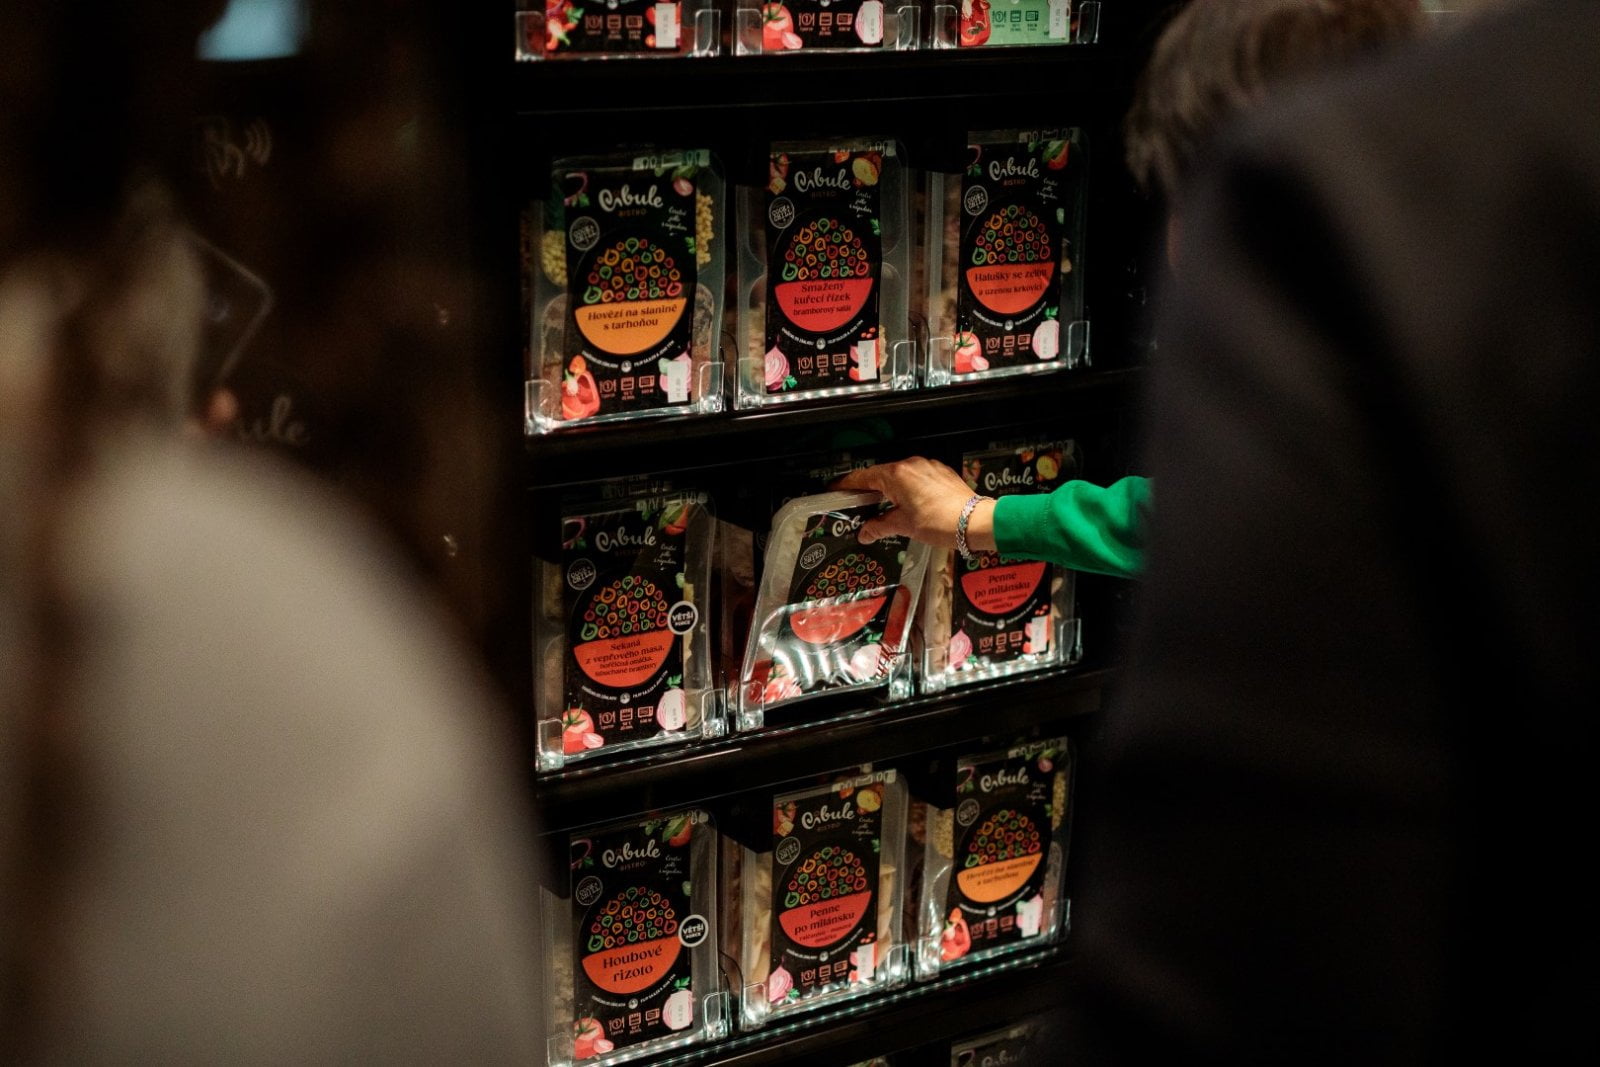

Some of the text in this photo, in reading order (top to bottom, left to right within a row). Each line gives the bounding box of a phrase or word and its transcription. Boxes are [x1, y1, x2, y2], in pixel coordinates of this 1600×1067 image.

[989, 156, 1040, 181] Cibule
[794, 166, 851, 192] Cibule
[598, 184, 664, 212] Cibule
[1012, 271, 1022, 279] se
[801, 281, 845, 293] Smažený
[794, 292, 851, 305] kuřecí řízek
[588, 304, 678, 321] Hovězí na slanině
[603, 323, 609, 331] s
[984, 466, 1035, 491] Cibule
[595, 525, 657, 552] Cibule
[989, 572, 1017, 584] Penne
[974, 581, 1030, 600] po milánsku
[611, 639, 641, 651] Sekaná
[593, 649, 640, 663] vepřového
[801, 801, 855, 830] Cibule
[602, 839, 661, 868] Cibule
[810, 904, 840, 918] Penne
[794, 925, 808, 935] po
[810, 912, 855, 930] milánsku
[603, 944, 663, 968] Houbové
[613, 964, 653, 982] rizoto
